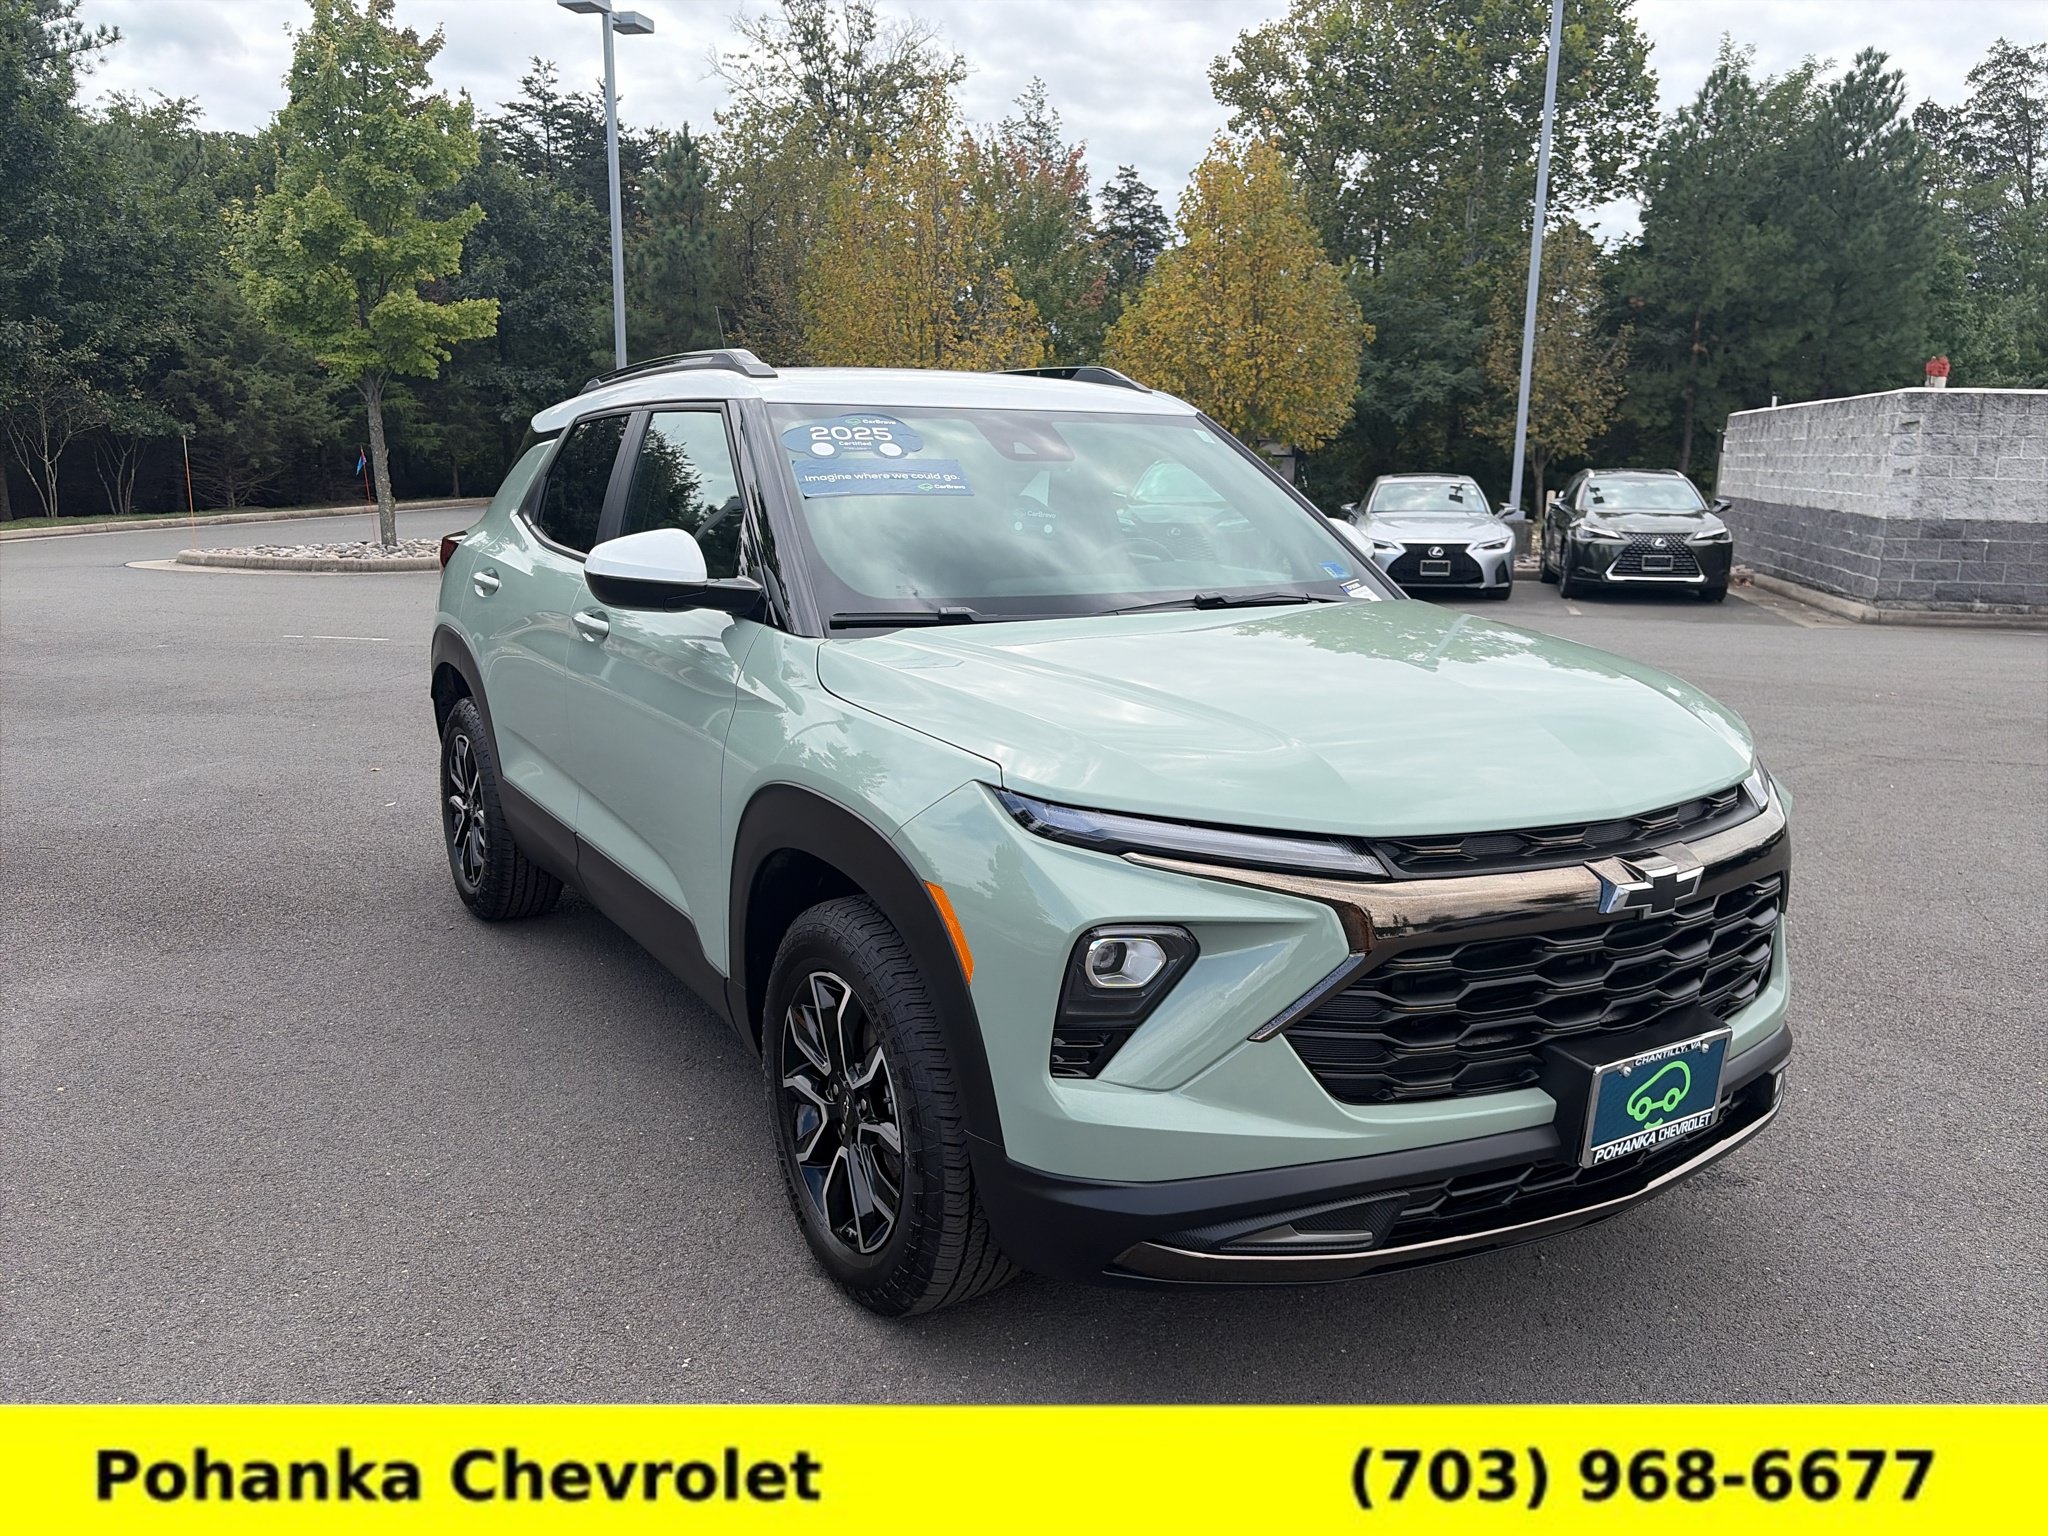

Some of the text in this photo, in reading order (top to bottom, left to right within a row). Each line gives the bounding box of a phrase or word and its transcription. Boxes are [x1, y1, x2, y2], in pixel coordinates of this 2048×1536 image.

[810, 426, 893, 441] 2025
[804, 474, 851, 482] Imagine
[853, 472, 889, 480] where
[911, 472, 941, 480] could
[944, 474, 960, 482] go.
[1635, 1041, 1702, 1066] CHANTILLY, VA
[1594, 1113, 1711, 1164] POHANKA CHEVROLET
